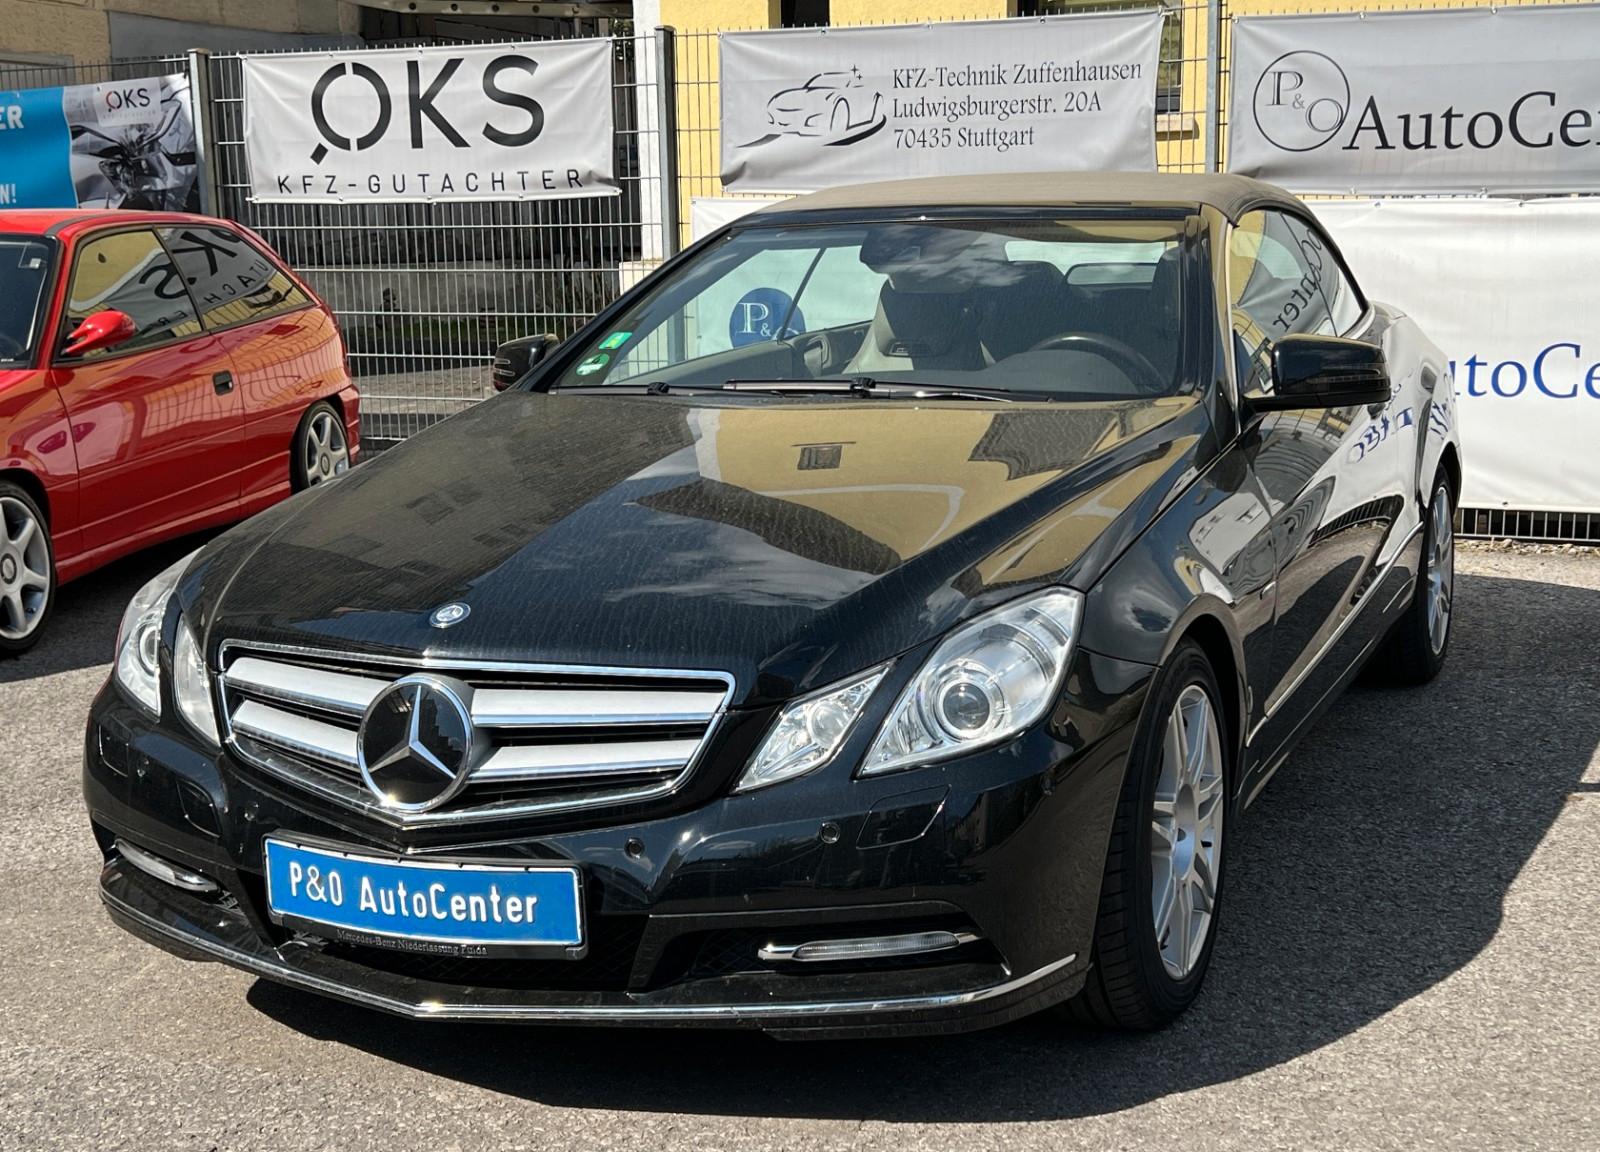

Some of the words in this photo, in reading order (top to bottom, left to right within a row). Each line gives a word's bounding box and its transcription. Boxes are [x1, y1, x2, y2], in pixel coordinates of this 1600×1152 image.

[893, 65, 1007, 89] KFZ-Technik
[1013, 60, 1142, 85] Zuffenhausen
[893, 95, 1057, 122] Ludwigsburgerstr.
[1063, 90, 1102, 112] 20A
[1342, 91, 1600, 150] AutoCe
[894, 128, 951, 149] 70435
[957, 126, 1035, 152] Stuttgart
[277, 169, 583, 195] KFZ-GUTACHTER
[359, 876, 538, 924] AutoCenter
